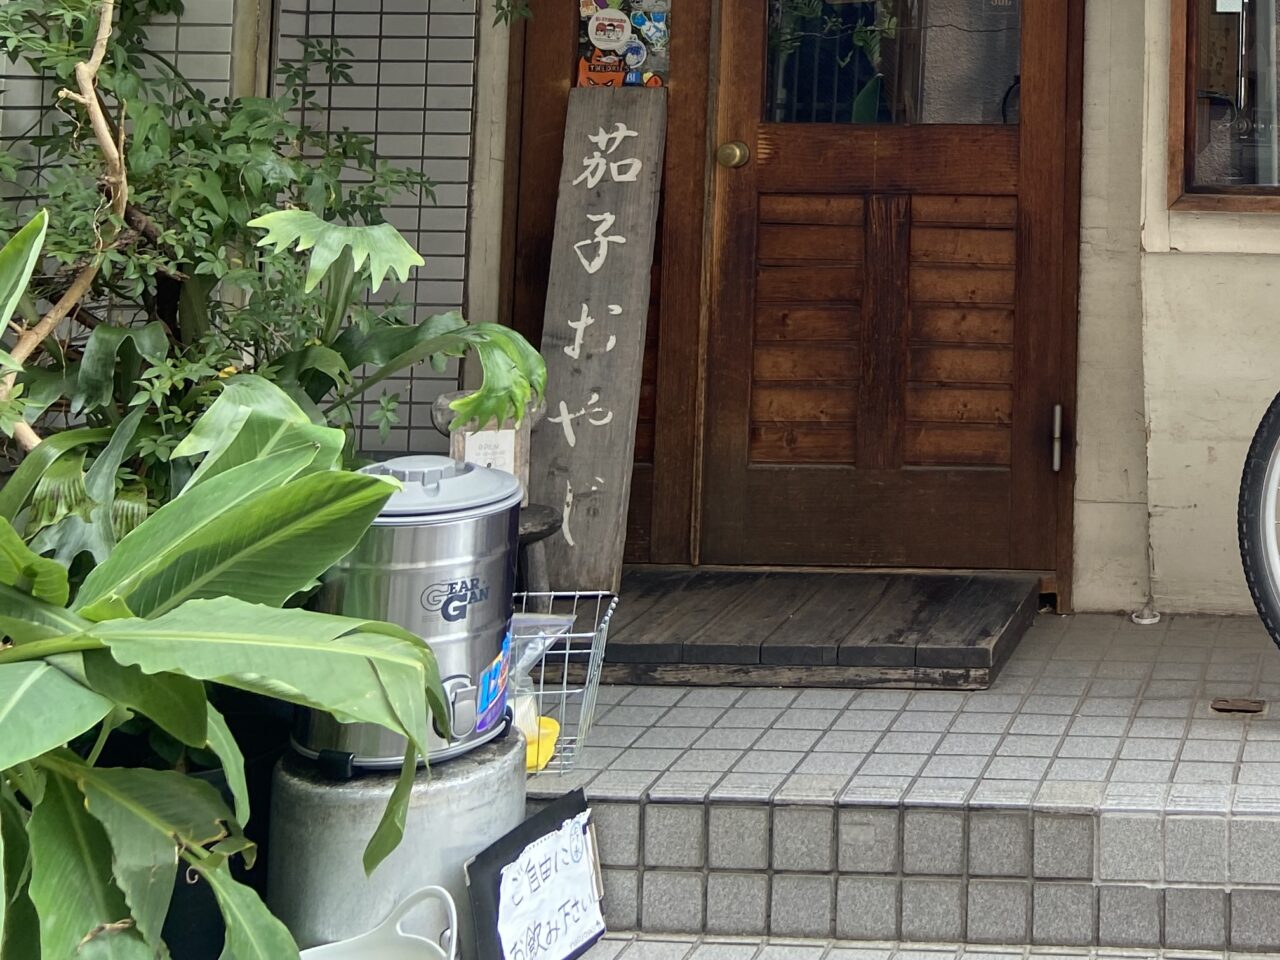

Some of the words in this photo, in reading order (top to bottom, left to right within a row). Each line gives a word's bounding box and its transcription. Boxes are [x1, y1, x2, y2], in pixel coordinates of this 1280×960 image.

[547, 122, 643, 546] 茄子おやじ
[511, 846, 571, 907] ご自由に
